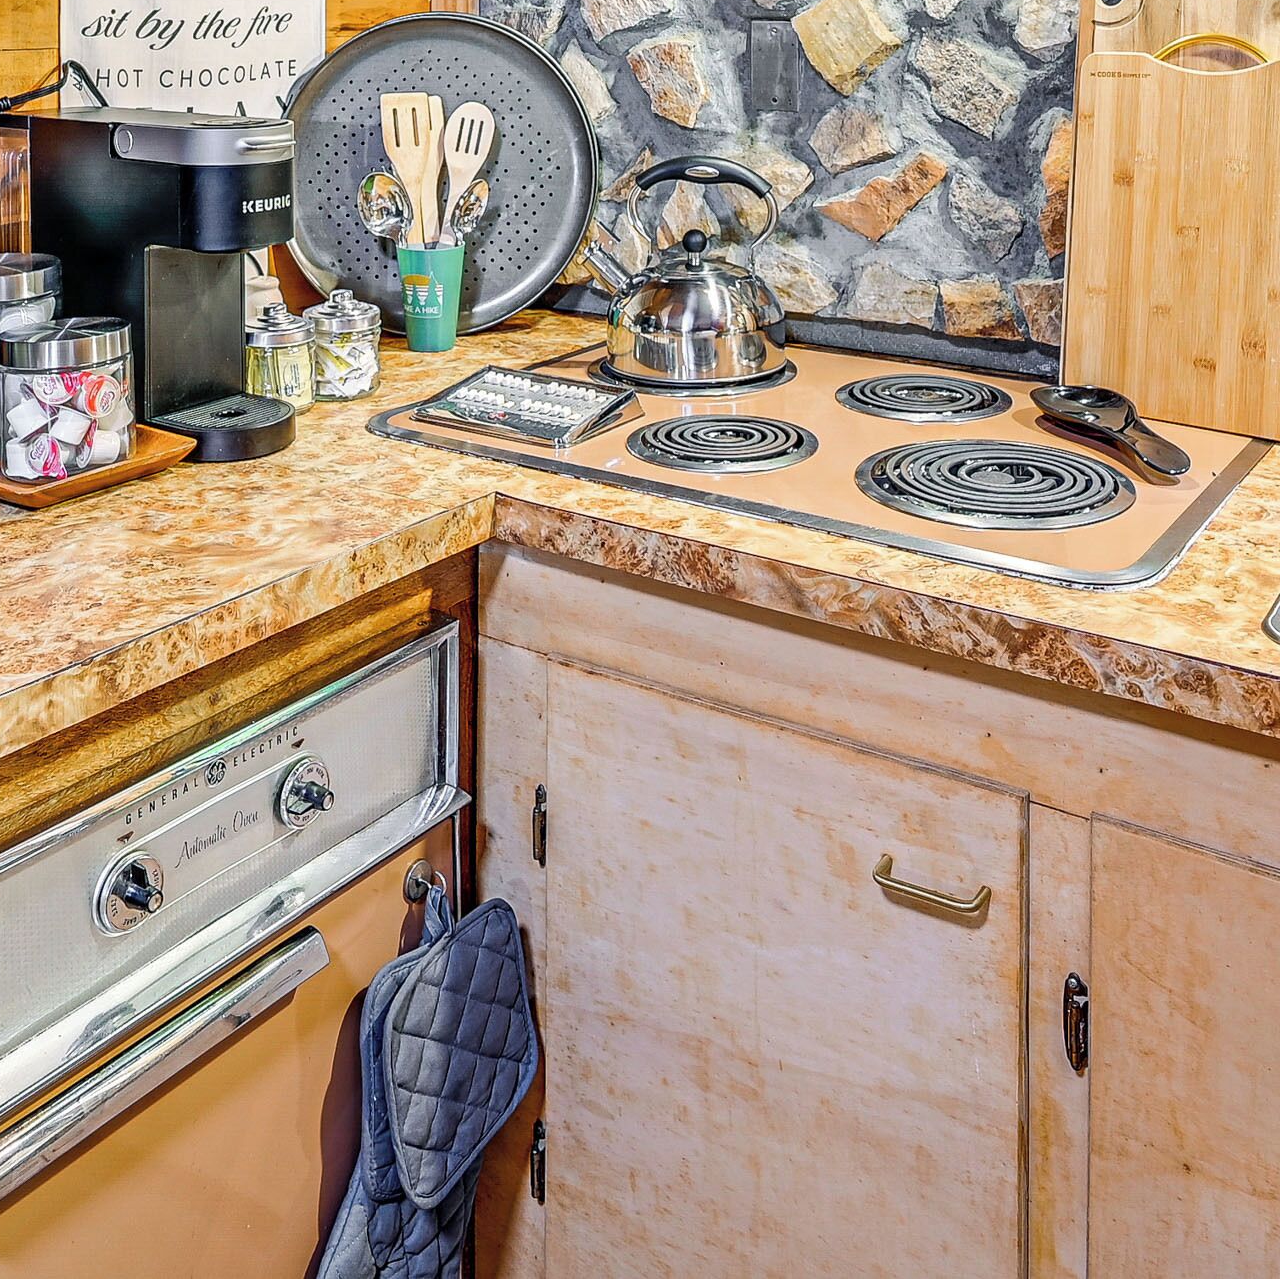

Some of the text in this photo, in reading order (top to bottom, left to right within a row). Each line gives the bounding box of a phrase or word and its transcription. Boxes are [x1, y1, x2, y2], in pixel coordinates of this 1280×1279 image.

[81, 6, 294, 51] sit by the fire
[95, 59, 297, 88] HOT CHOCOLATE
[242, 194, 291, 214] KEURIG
[422, 306, 440, 314] HIKE
[125, 779, 199, 825] GENERAL
[233, 725, 299, 767] ELECTRIC
[174, 809, 259, 869] Automatic Oven
